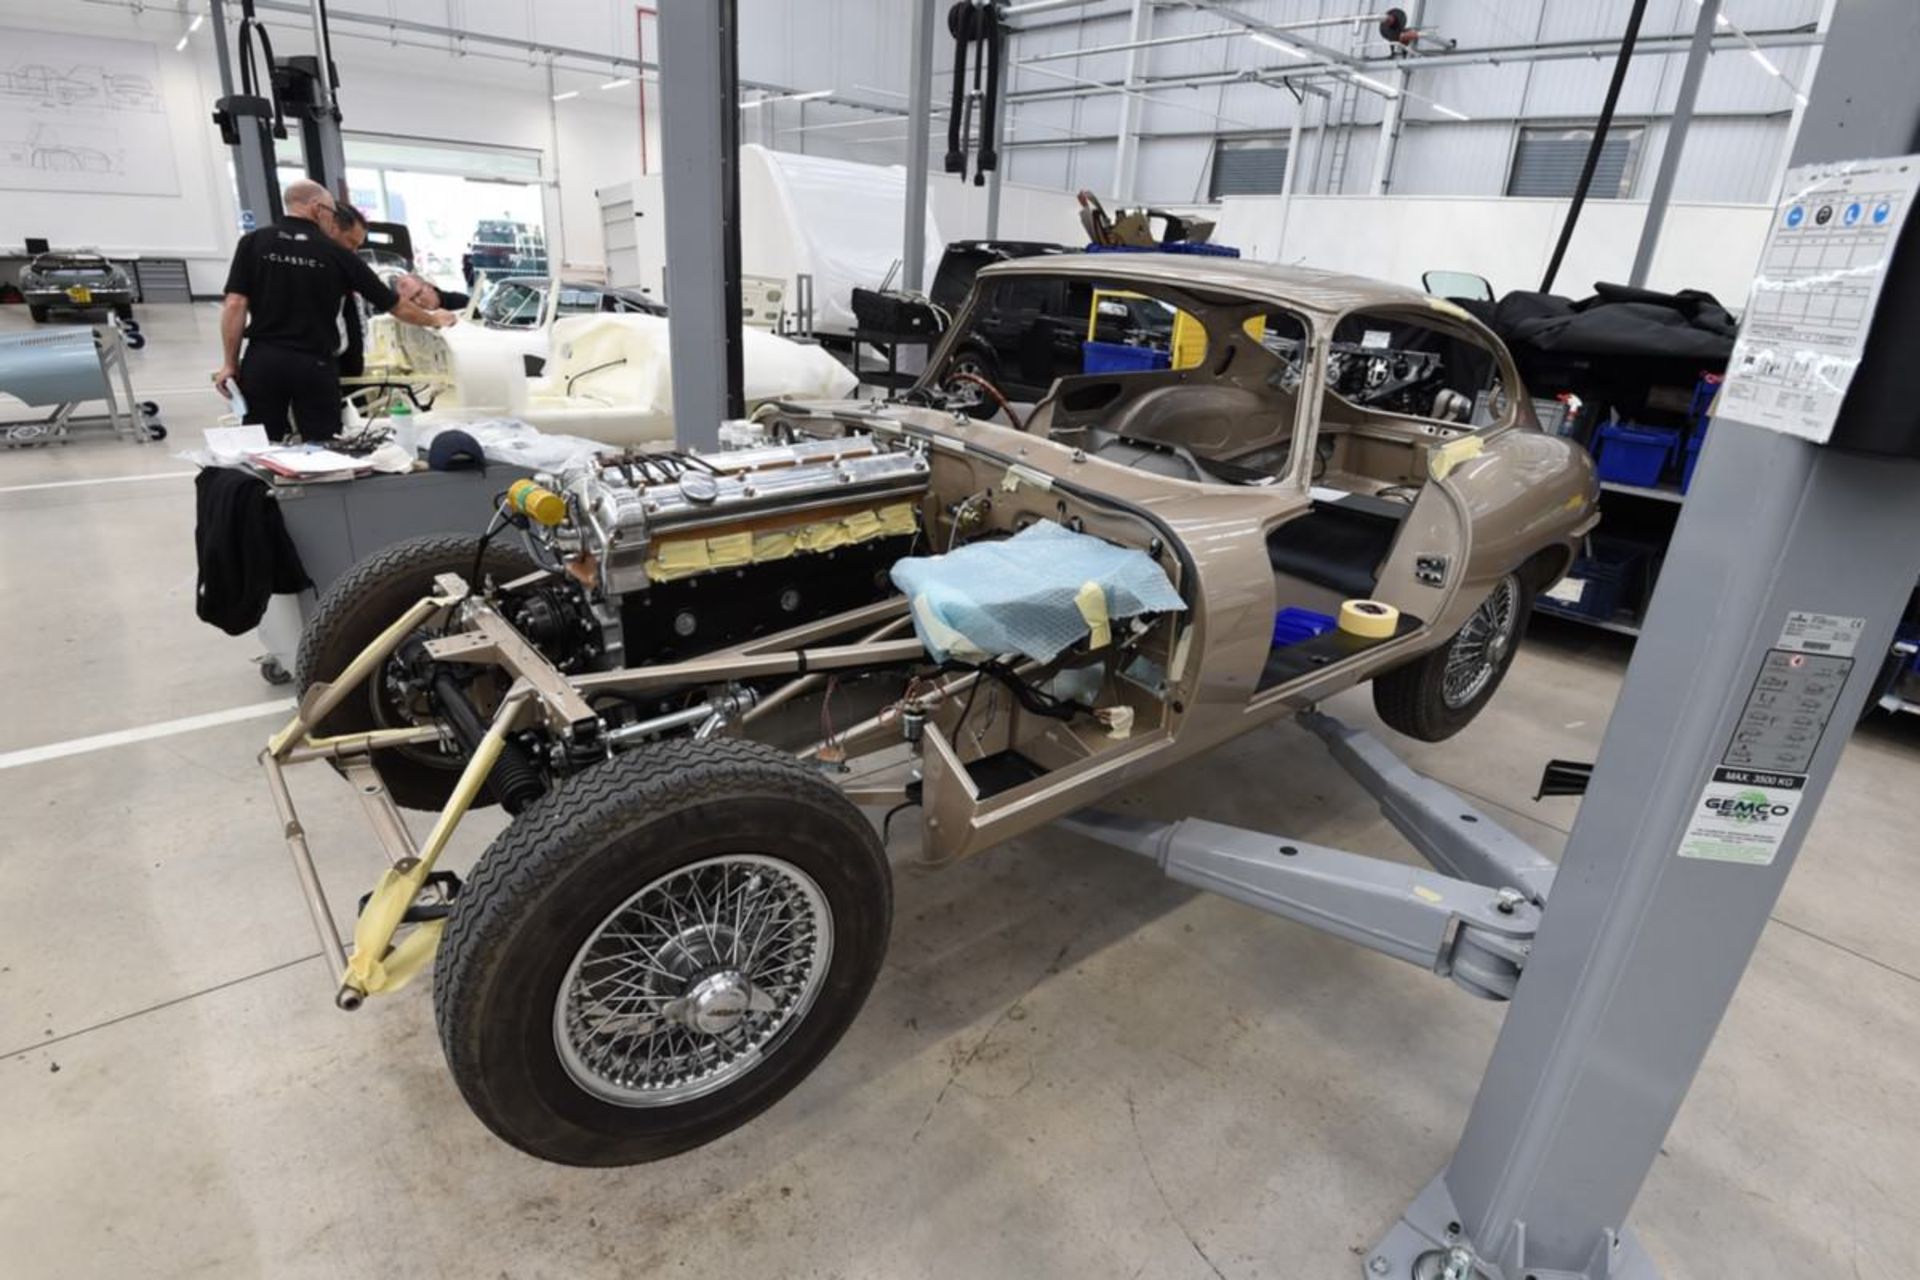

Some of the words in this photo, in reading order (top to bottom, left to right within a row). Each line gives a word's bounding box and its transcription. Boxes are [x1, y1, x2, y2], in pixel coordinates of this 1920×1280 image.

[1752, 774, 1776, 786] 3500
[1777, 778, 1794, 787] KG
[1705, 798, 1789, 816] GEMCO
